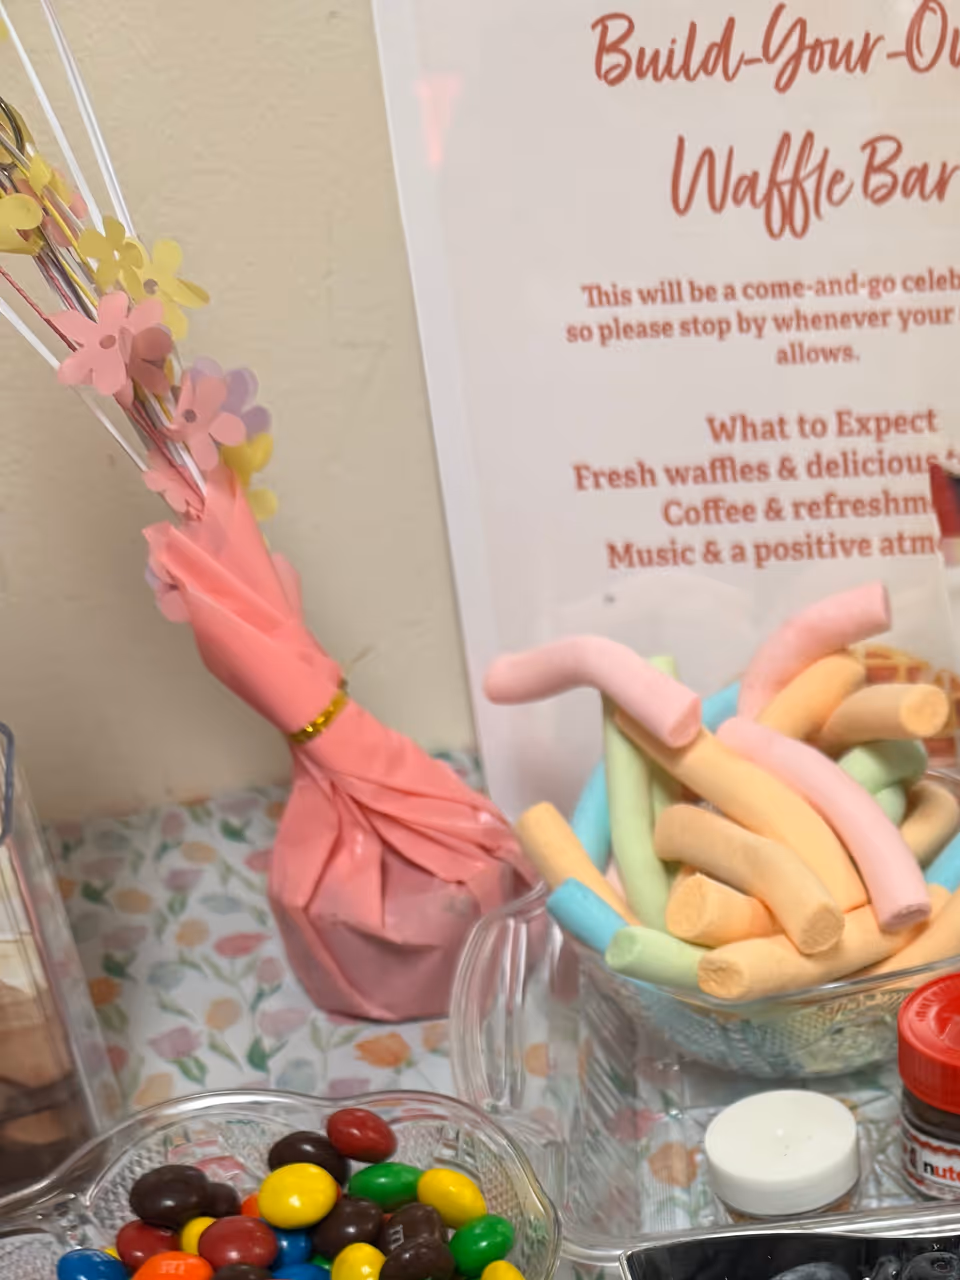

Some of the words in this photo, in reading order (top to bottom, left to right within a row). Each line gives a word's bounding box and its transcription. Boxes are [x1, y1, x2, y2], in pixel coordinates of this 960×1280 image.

[671, 130, 854, 240] Waffle
[582, 282, 633, 308] This
[637, 280, 684, 306] will
[688, 279, 718, 303] be
[722, 285, 737, 302] a
[741, 270, 896, 300] come-and-go
[566, 324, 593, 343] so
[599, 316, 674, 346] please
[679, 314, 732, 341] stop
[737, 310, 767, 339] by
[773, 305, 890, 333] whenever
[898, 304, 954, 333] your
[776, 342, 860, 365] allows.
[706, 413, 790, 444] What
[797, 416, 829, 438] to
[835, 408, 940, 442] Expect
[573, 460, 659, 491] Fresh
[663, 456, 772, 487] waffles
[776, 457, 799, 482] &
[661, 493, 759, 526] Coffee
[763, 497, 787, 521] &
[791, 488, 932, 518] refreshm
[606, 537, 697, 569] Music
[700, 540, 724, 564] &
[730, 545, 746, 562] a
[754, 533, 873, 567] positive
